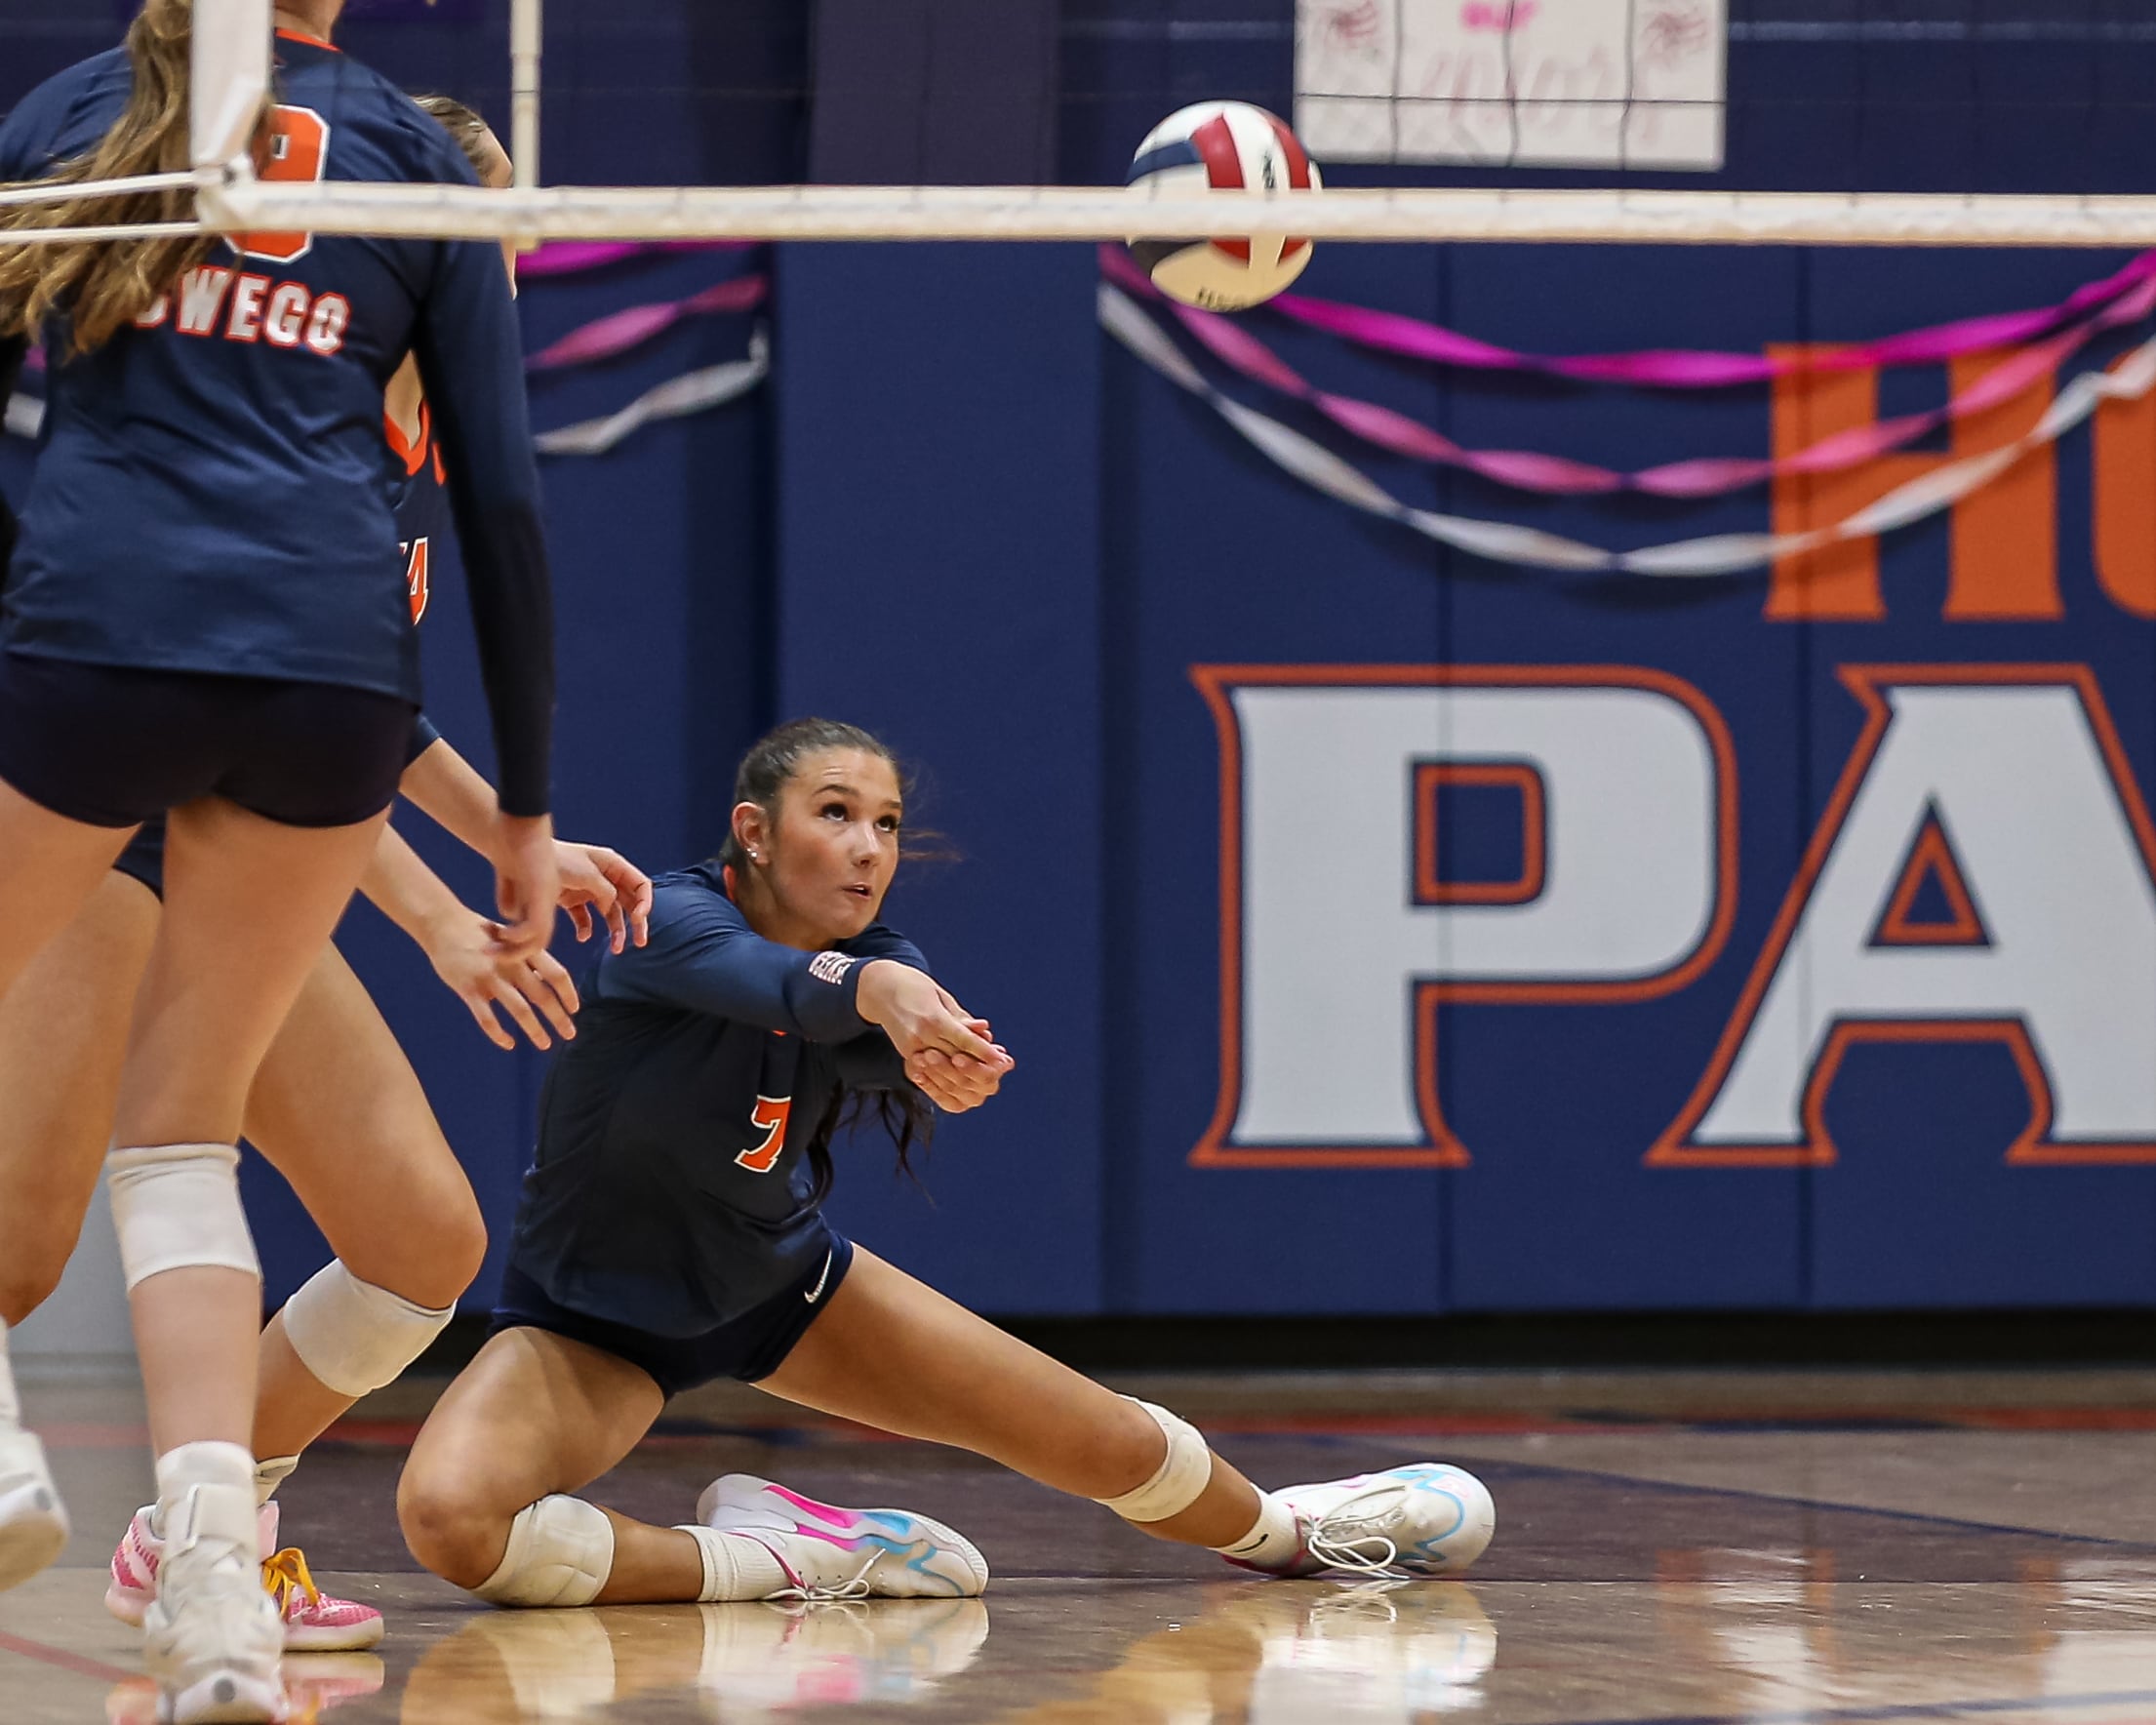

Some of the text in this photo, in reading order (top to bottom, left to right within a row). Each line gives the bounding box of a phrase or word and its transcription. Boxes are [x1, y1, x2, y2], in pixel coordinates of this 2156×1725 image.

[134, 264, 352, 356] WEGO
[1763, 342, 2156, 622] H
[1189, 663, 2156, 1166] PA
[734, 1095, 791, 1173] 7
